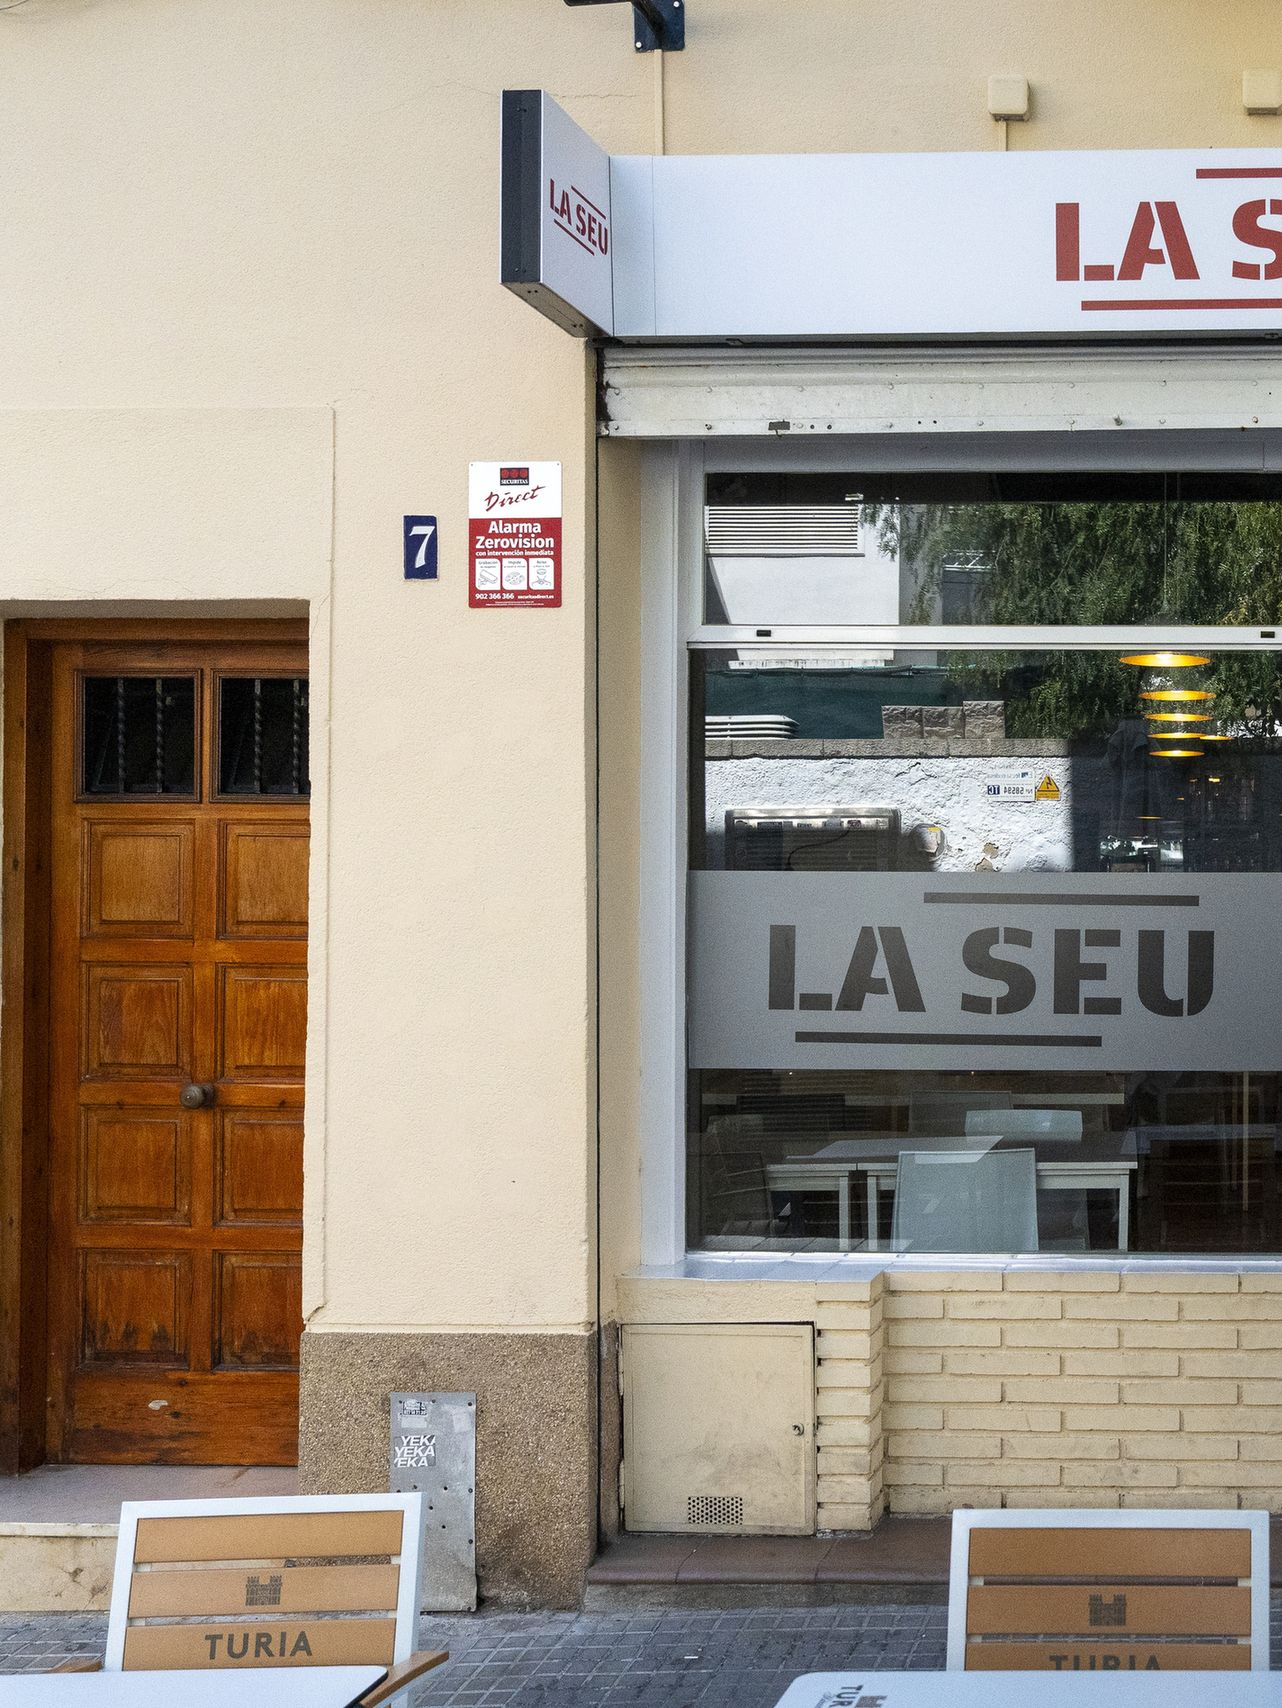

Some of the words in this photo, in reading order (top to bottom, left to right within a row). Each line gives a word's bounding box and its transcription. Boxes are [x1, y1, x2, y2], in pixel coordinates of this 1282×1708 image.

[550, 178, 572, 226] LA
[576, 203, 608, 255] SEU
[1055, 200, 1200, 281] LA
[484, 485, 547, 512] Direct
[488, 519, 541, 533] Alarma
[409, 525, 435, 569] 7
[475, 534, 554, 549] Zerovision
[768, 924, 927, 1013] LA
[960, 926, 1215, 1018] SEU
[394, 1446, 435, 1458] YEKA
[205, 1630, 313, 1660] TURIA
